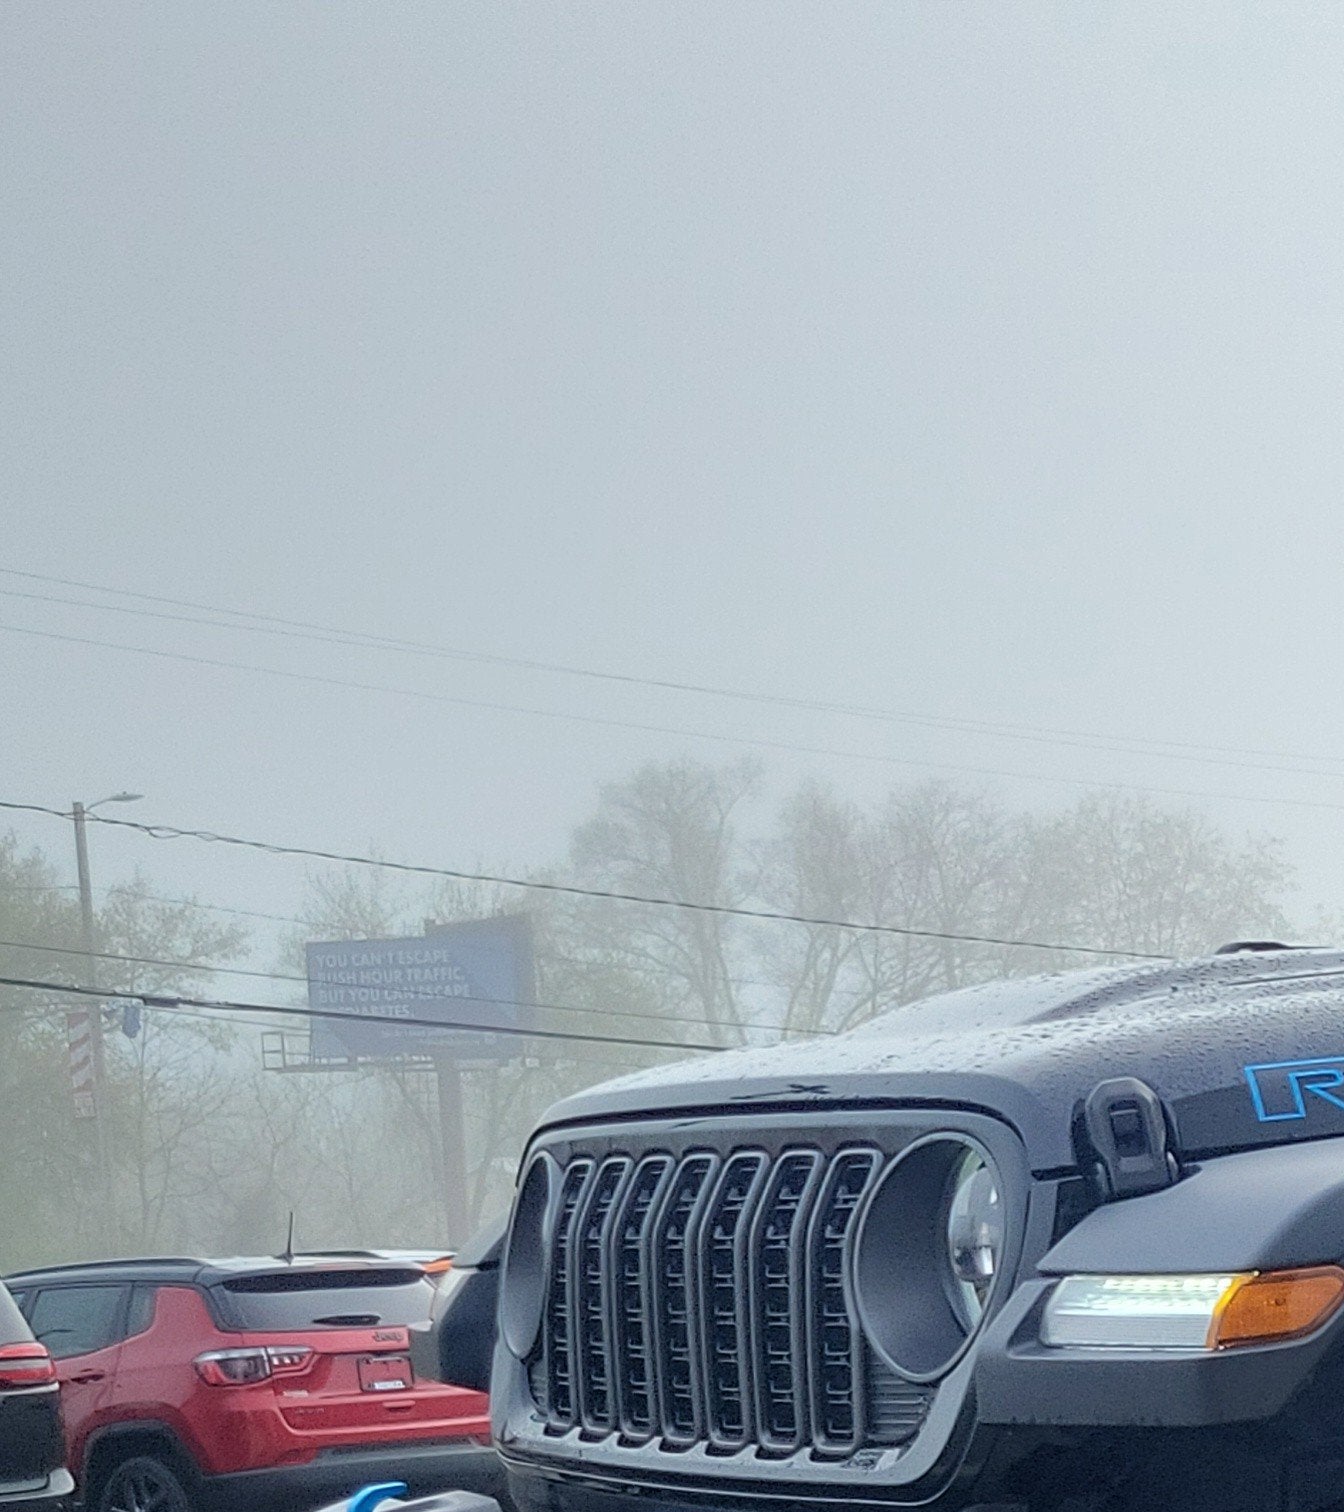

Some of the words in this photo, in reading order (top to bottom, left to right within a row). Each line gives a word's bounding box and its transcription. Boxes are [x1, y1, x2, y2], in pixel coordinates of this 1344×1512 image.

[315, 954, 348, 969] YOU
[398, 949, 449, 965] ESCAPE
[317, 970, 357, 985] RUSH
[360, 968, 403, 984] HOUR
[319, 989, 345, 1003] BUT
[347, 987, 380, 1002] YOU
[419, 984, 471, 1000] ESCAPE
